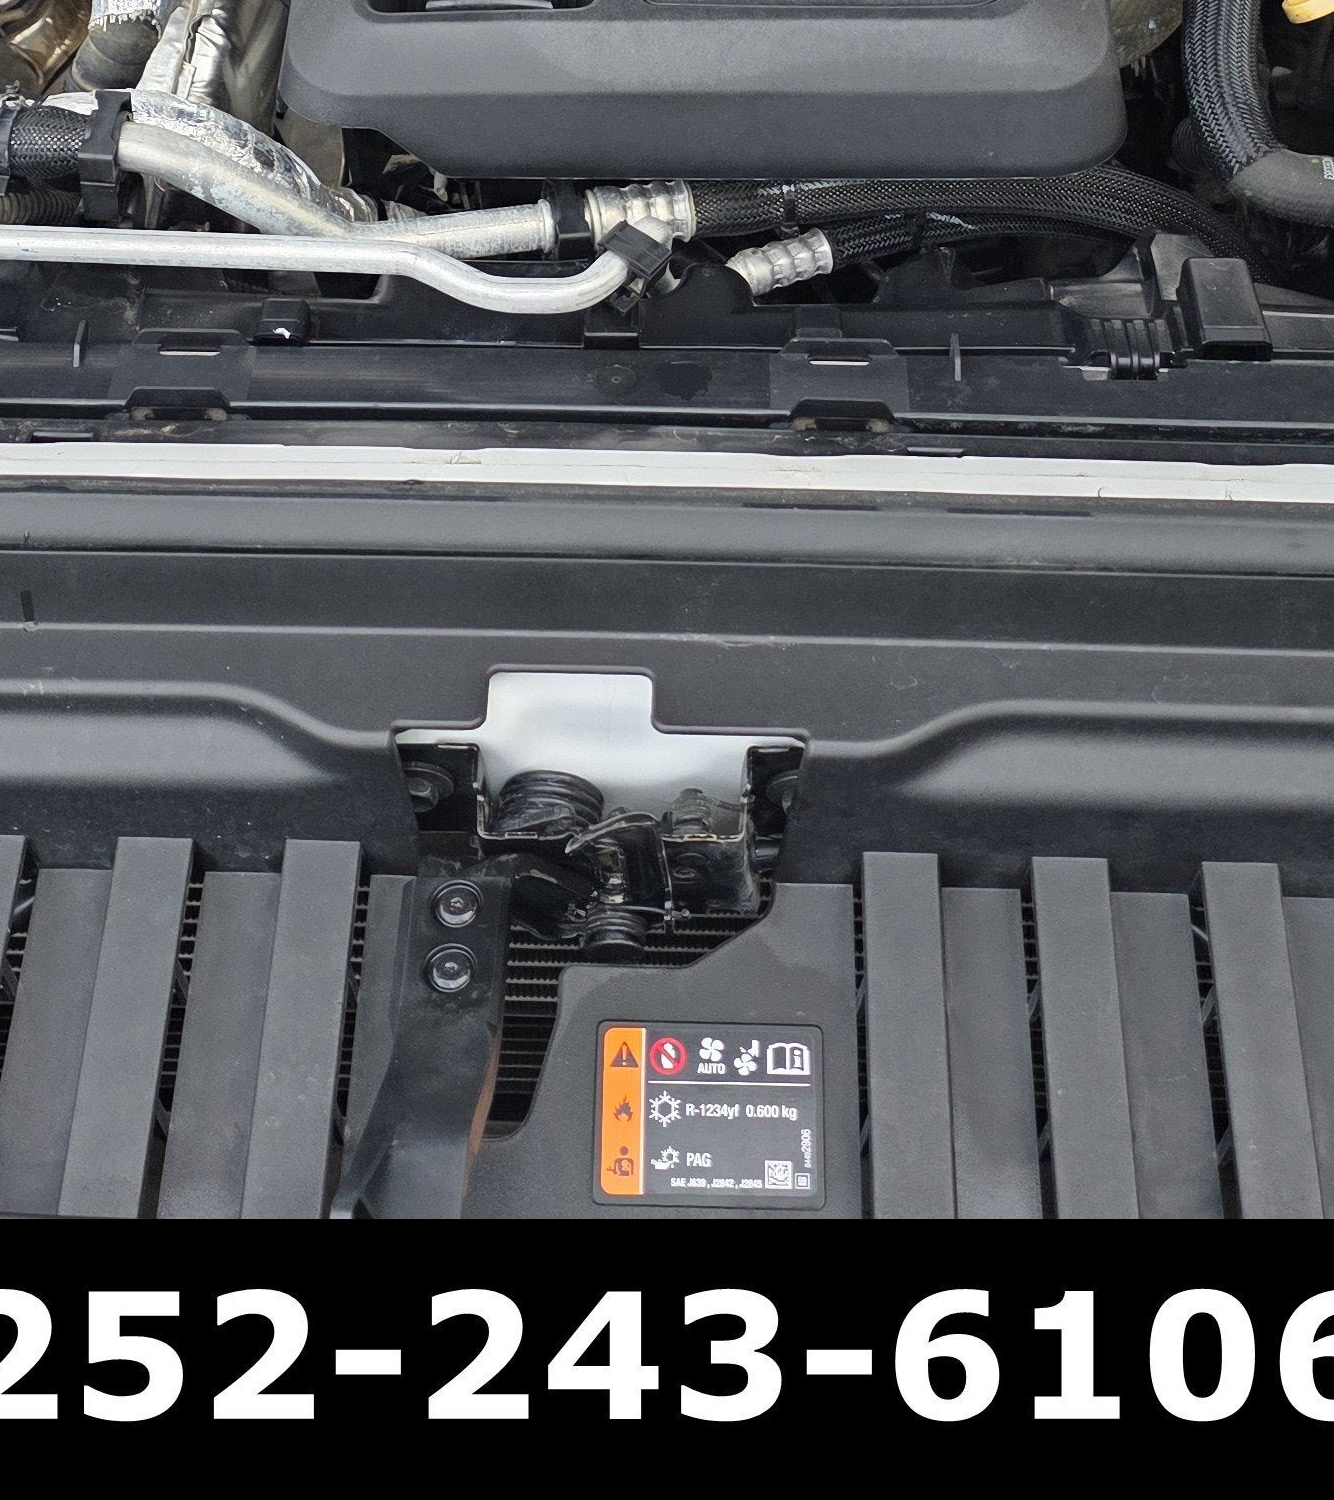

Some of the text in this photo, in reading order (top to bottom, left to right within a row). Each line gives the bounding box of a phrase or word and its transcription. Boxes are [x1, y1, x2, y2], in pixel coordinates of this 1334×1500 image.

[697, 1062, 726, 1075] AUTO
[685, 1103, 798, 1121] R-1234yf 0.600 kg
[686, 1152, 712, 1167] PAG
[670, 1177, 686, 1188] SAE
